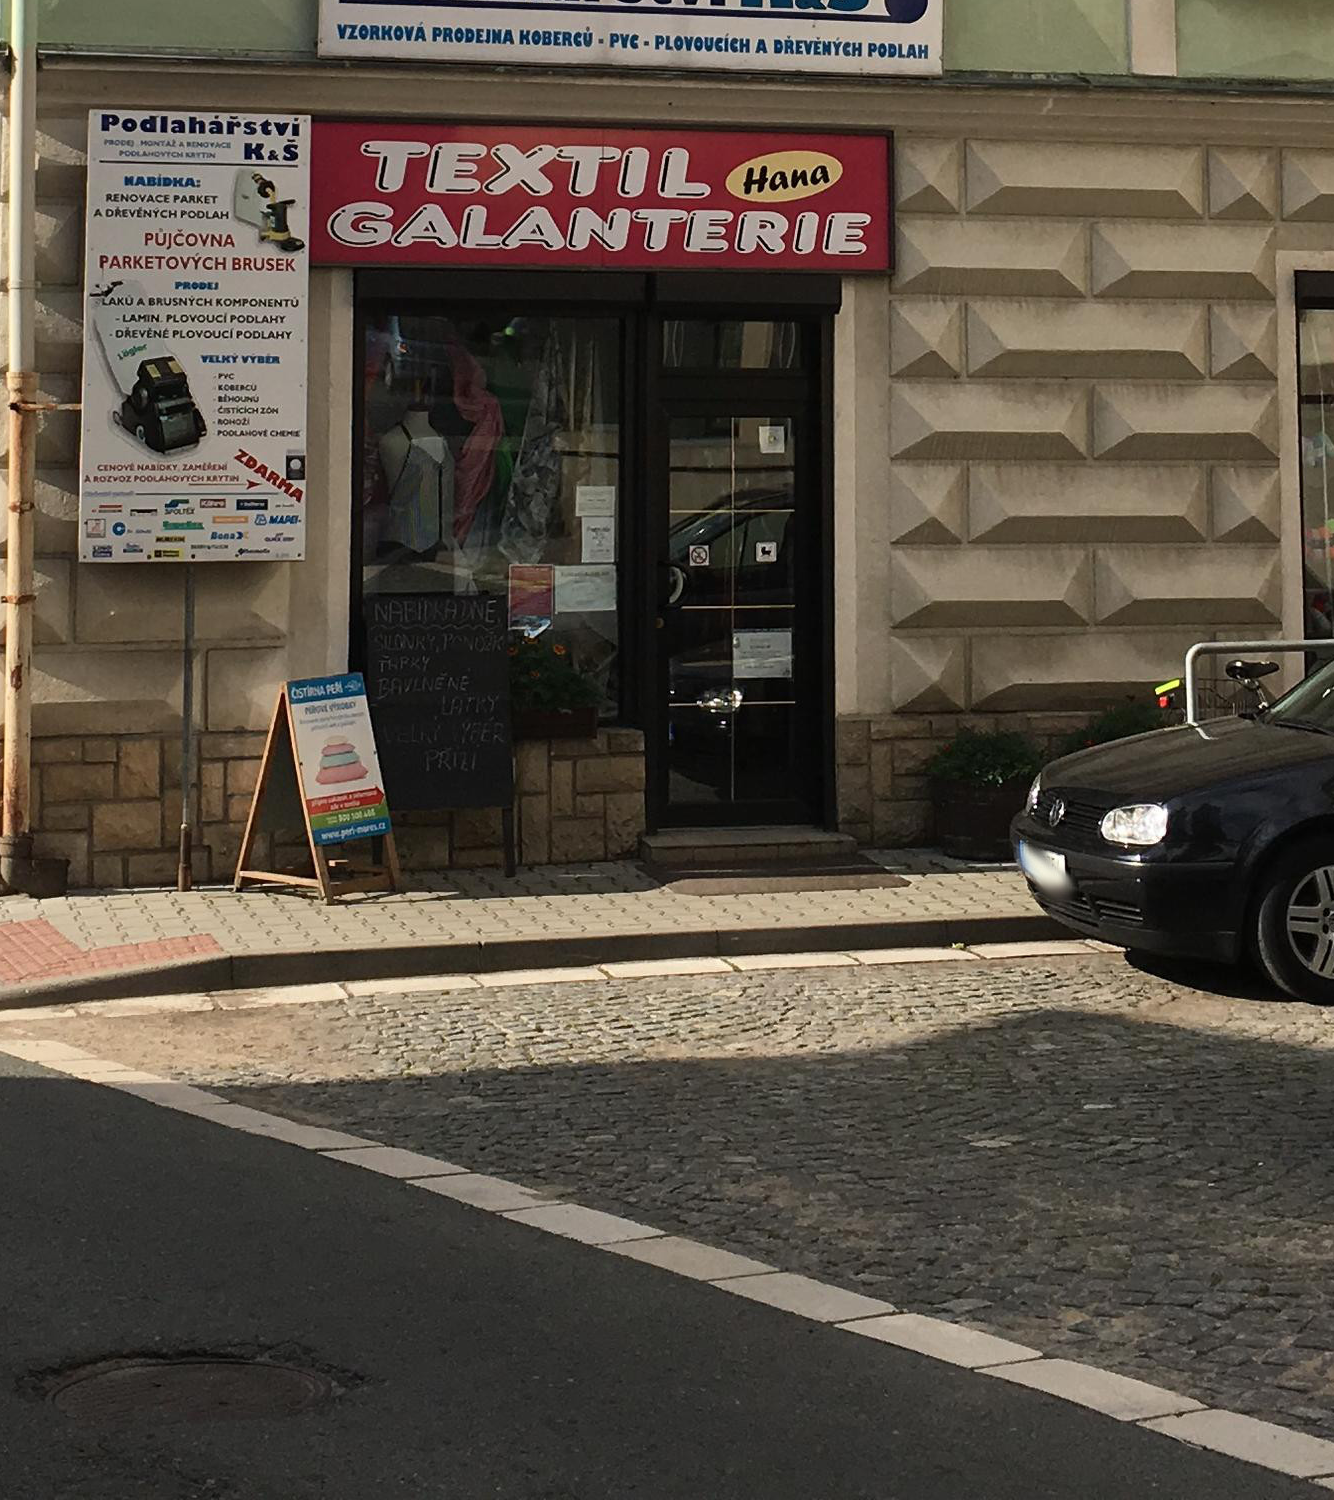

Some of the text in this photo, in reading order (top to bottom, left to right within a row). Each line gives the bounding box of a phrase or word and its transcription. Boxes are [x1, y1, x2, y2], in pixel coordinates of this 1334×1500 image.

[336, 22, 427, 42] VZORKOVÁ
[431, 27, 515, 46] PRODEJNA
[519, 27, 594, 48] KOBERCŮ
[609, 33, 639, 50] PVC
[654, 33, 750, 54] PLOVOUCÍCH
[755, 38, 768, 54] A
[773, 35, 862, 58] DŘEVĚNÝCH
[867, 42, 929, 59] PODLAH
[100, 113, 301, 137] Podlahářství
[186, 141, 232, 150] RENOVACE
[185, 151, 217, 159] KRYTIN
[360, 140, 831, 199] TEXTIL Hana
[123, 173, 201, 188] NABÍDKA:
[105, 193, 218, 204] RENOVACE PARKET
[93, 206, 230, 220] A DŘEVĚNÝCH PODLAH
[326, 200, 872, 256] GALANTERIE
[144, 227, 236, 249] PŮJČOVNA
[99, 253, 296, 272] PARKETOVÝCH BRUSEK
[174, 281, 219, 291] PRODEJ
[136, 297, 145, 307] A
[148, 295, 214, 308] BRUSNÝCH
[215, 296, 300, 308] KOMPONENTŮ
[166, 312, 228, 324] PLOVOUCÍ
[230, 315, 286, 324] PODLAHY
[115, 327, 169, 339] DŘEVĚNÉ
[172, 328, 234, 339] PLOVOUCÍ
[236, 330, 293, 340] PODLAHY
[200, 353, 281, 365] VELKÝ VÝBĚR
[217, 428, 301, 438] PODLAHOVÉ CHEMIE
[97, 462, 136, 472] CENOVÉ
[182, 462, 228, 472] ZAMĚŘENÍ
[83, 473, 240, 483] A ROZVOZ PODLAHOVÝCH KRYTIN
[233, 448, 305, 503] ZDARMA
[268, 515, 299, 524] MAPEI
